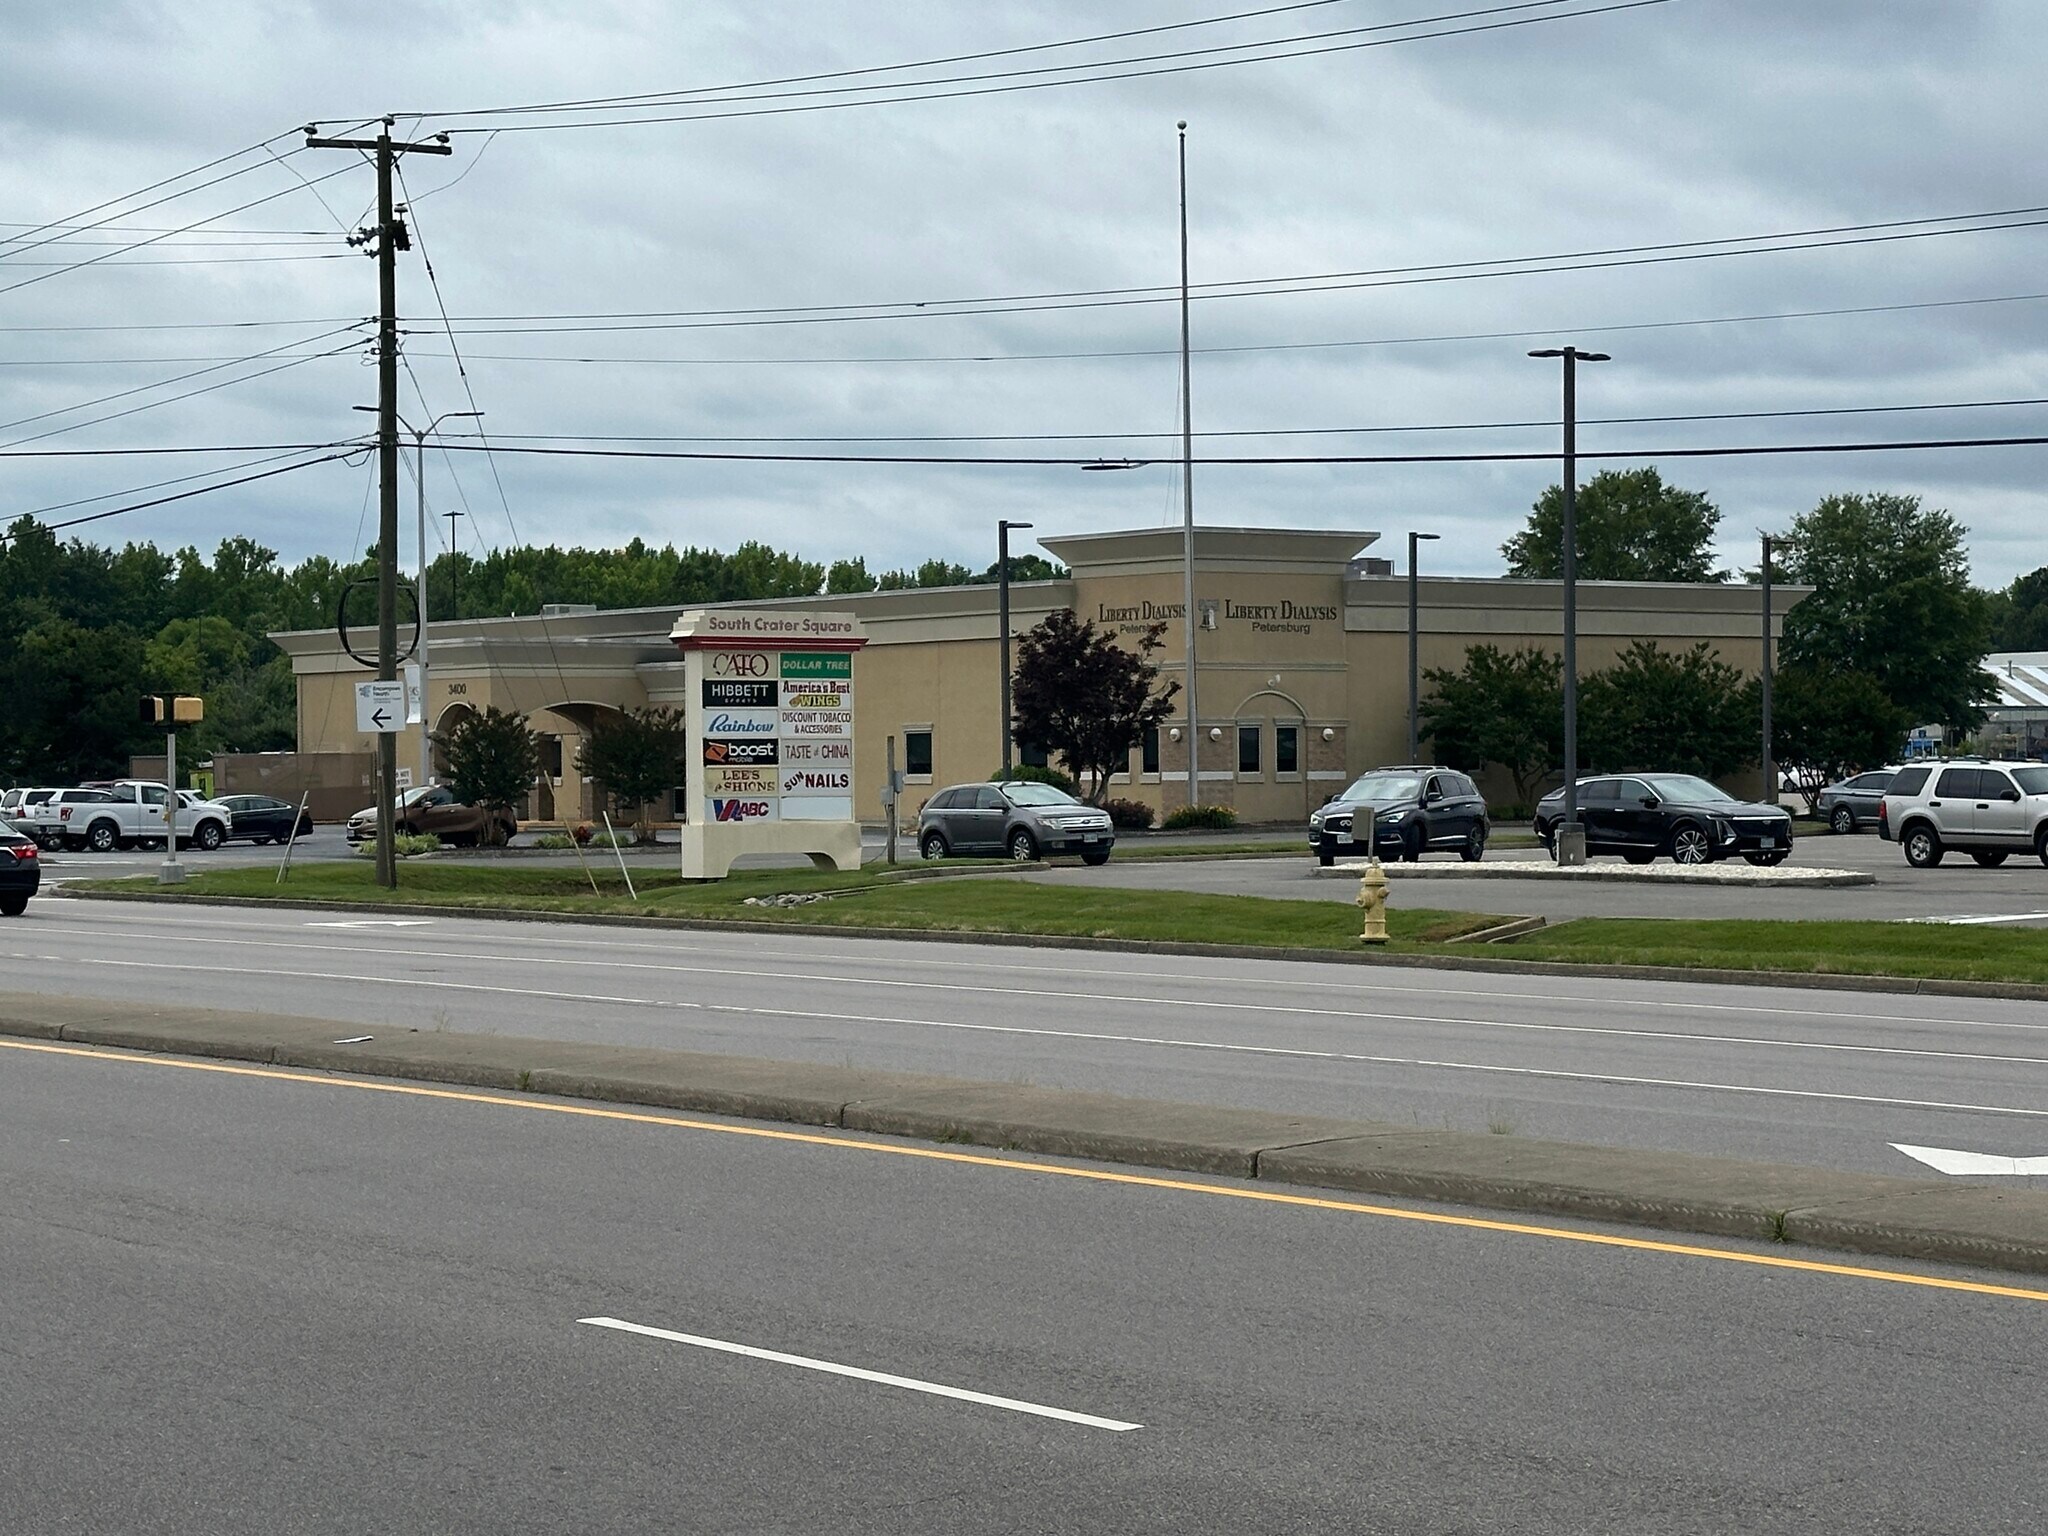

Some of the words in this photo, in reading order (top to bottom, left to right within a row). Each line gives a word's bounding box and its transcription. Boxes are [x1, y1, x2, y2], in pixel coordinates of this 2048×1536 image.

[1225, 599, 1278, 620] LIBERTY
[1281, 600, 1337, 620] DIALYSIS
[709, 617, 750, 631] South
[754, 618, 799, 632] Crater
[802, 619, 852, 635] Square
[1252, 622, 1311, 634] Petersburg
[713, 653, 769, 677] CATO
[782, 660, 822, 670] DOLLAR
[826, 661, 850, 670] TREE
[448, 683, 467, 695] 3400
[711, 684, 769, 697] HIBBETT
[783, 680, 828, 694] America's
[830, 681, 850, 694] Best
[800, 694, 840, 706] WINGS
[708, 713, 774, 732] Rainbow
[782, 712, 817, 722] DISCOUNT
[819, 712, 851, 722] TOBACCO
[794, 724, 799, 734] &
[801, 724, 843, 734] ACCESSORIES
[728, 742, 774, 756] boost
[785, 745, 812, 759] TASTE
[822, 745, 849, 759] CHINA
[784, 771, 804, 791] SUN
[805, 774, 849, 788] NAILS
[740, 802, 769, 816] ABC
